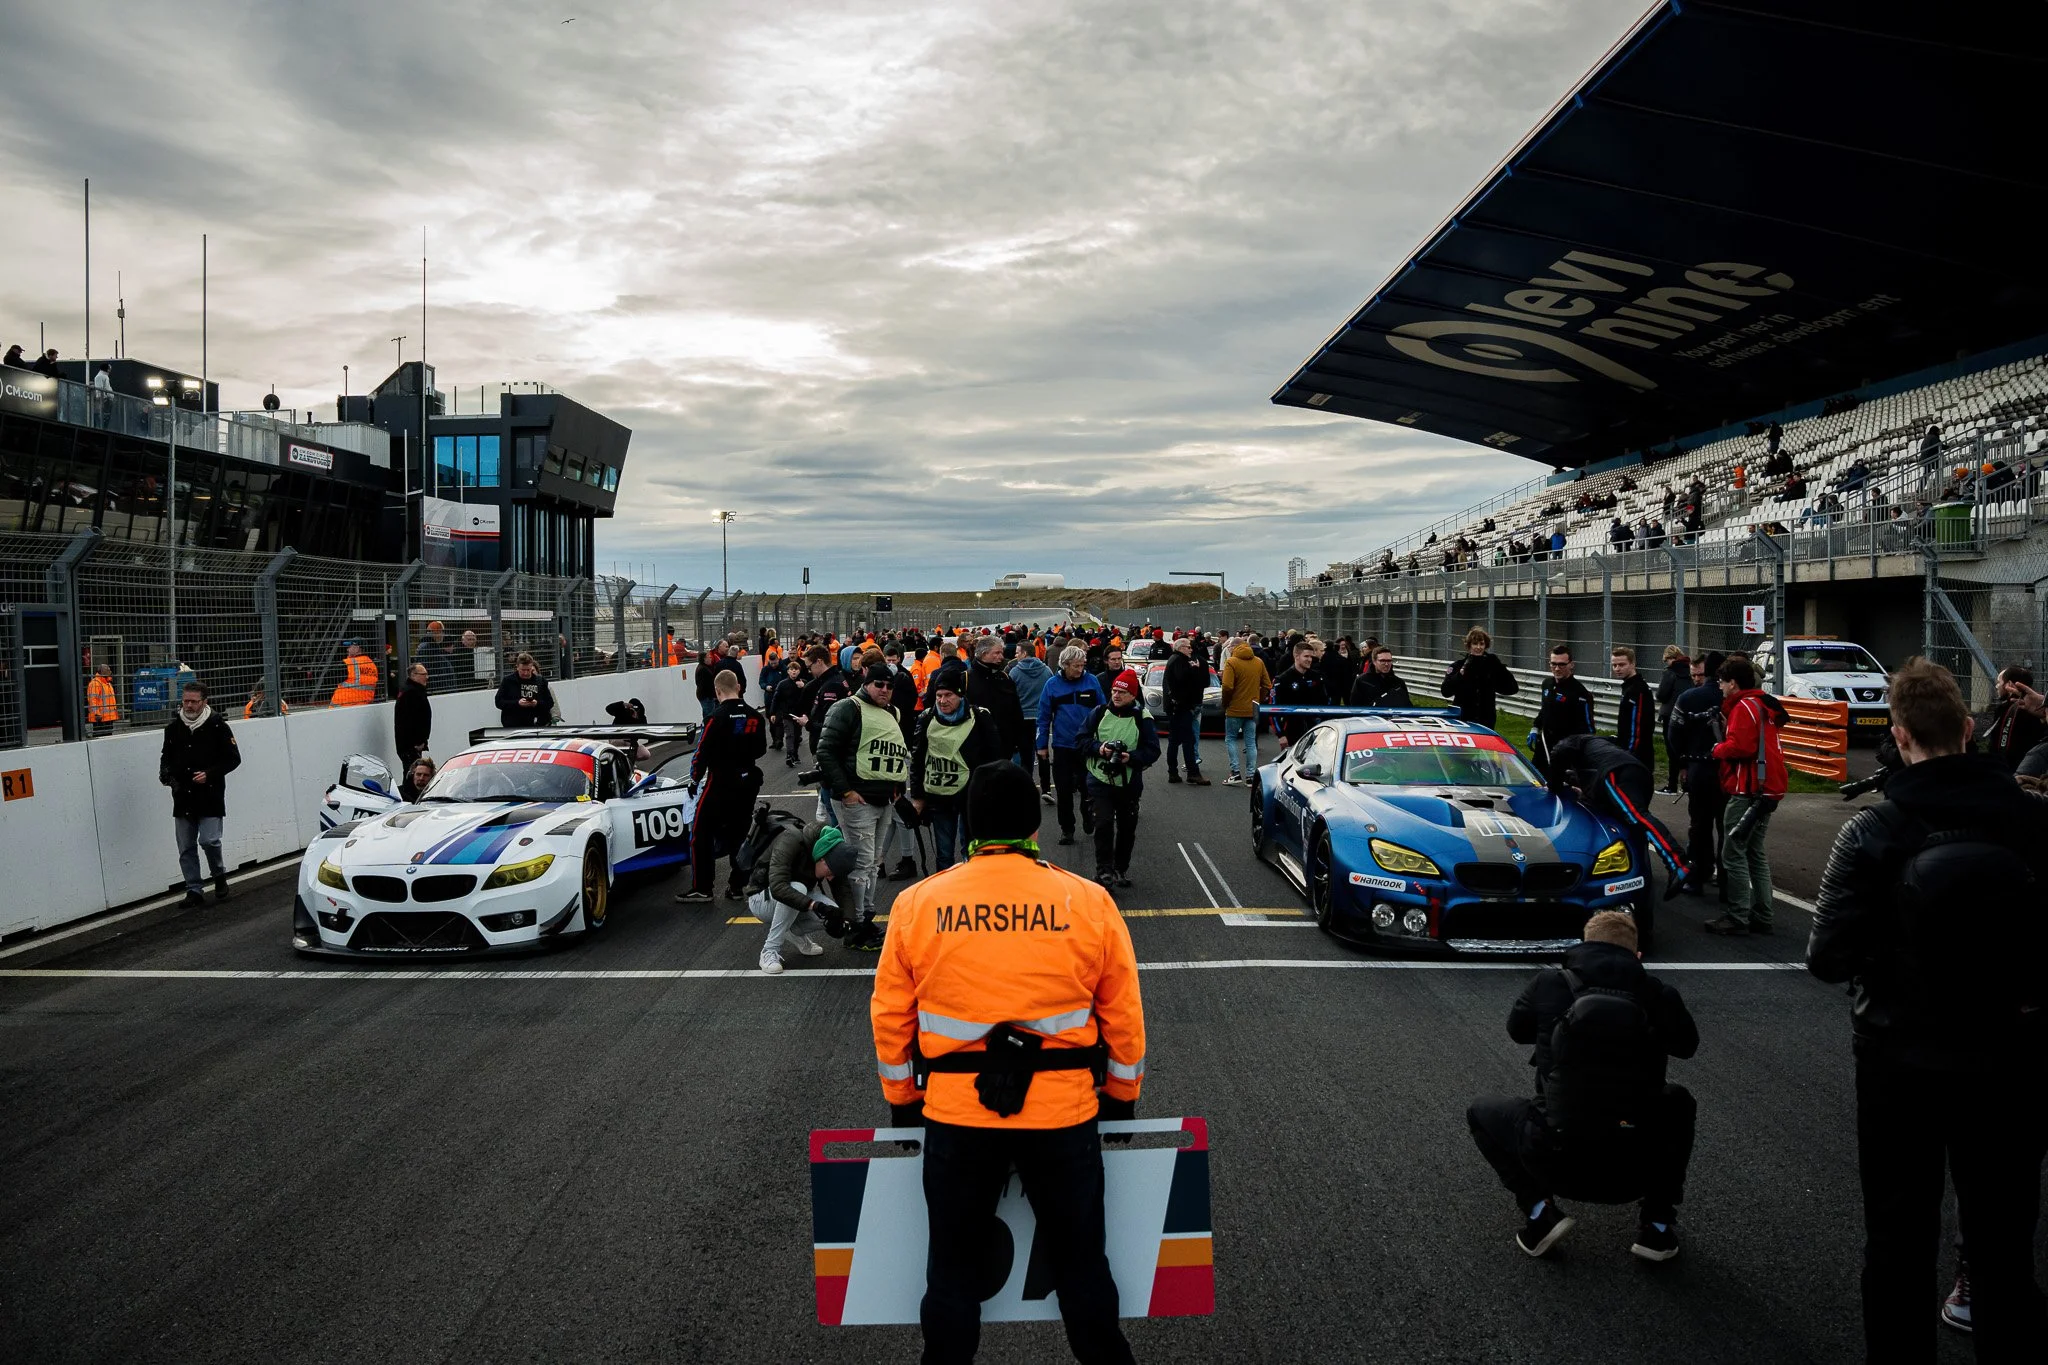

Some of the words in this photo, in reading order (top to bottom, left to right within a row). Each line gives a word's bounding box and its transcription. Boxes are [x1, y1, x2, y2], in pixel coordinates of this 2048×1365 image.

[5, 384, 43, 403] CM.com
[140, 686, 157, 696] Collé
[1382, 734, 1476, 751] FEBO
[470, 750, 559, 766] FEBO
[868, 757, 905, 773] 117
[3, 776, 15, 797] R
[19, 773, 27, 794] 1
[925, 771, 960, 787] 132
[635, 807, 684, 842] 109
[936, 903, 1069, 933] MARSHAL
